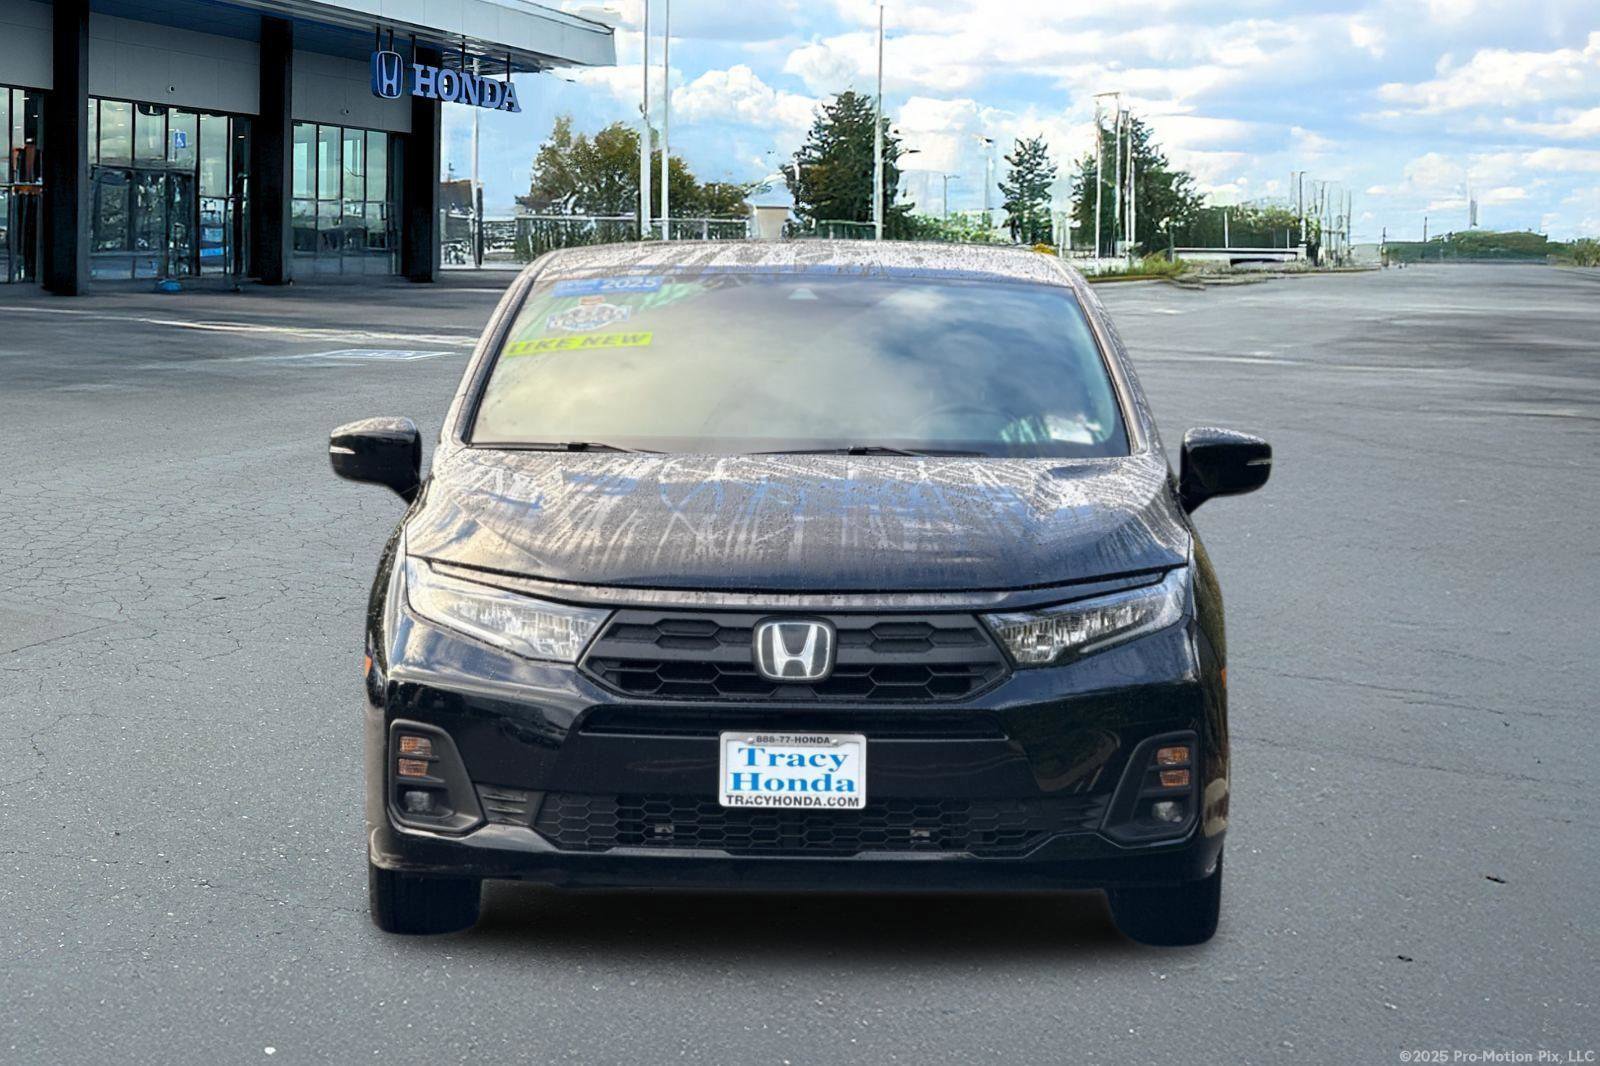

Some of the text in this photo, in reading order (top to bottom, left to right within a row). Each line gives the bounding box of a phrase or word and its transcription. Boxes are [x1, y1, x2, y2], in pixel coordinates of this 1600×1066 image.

[412, 63, 522, 113] HONDA
[600, 276, 658, 290] 2025
[581, 333, 650, 347] NEW
[756, 735, 831, 745] 888-77-HONDA
[738, 747, 849, 773] Tracy
[730, 772, 856, 793] Honda
[726, 794, 860, 807] TRACYHONDA.COM
